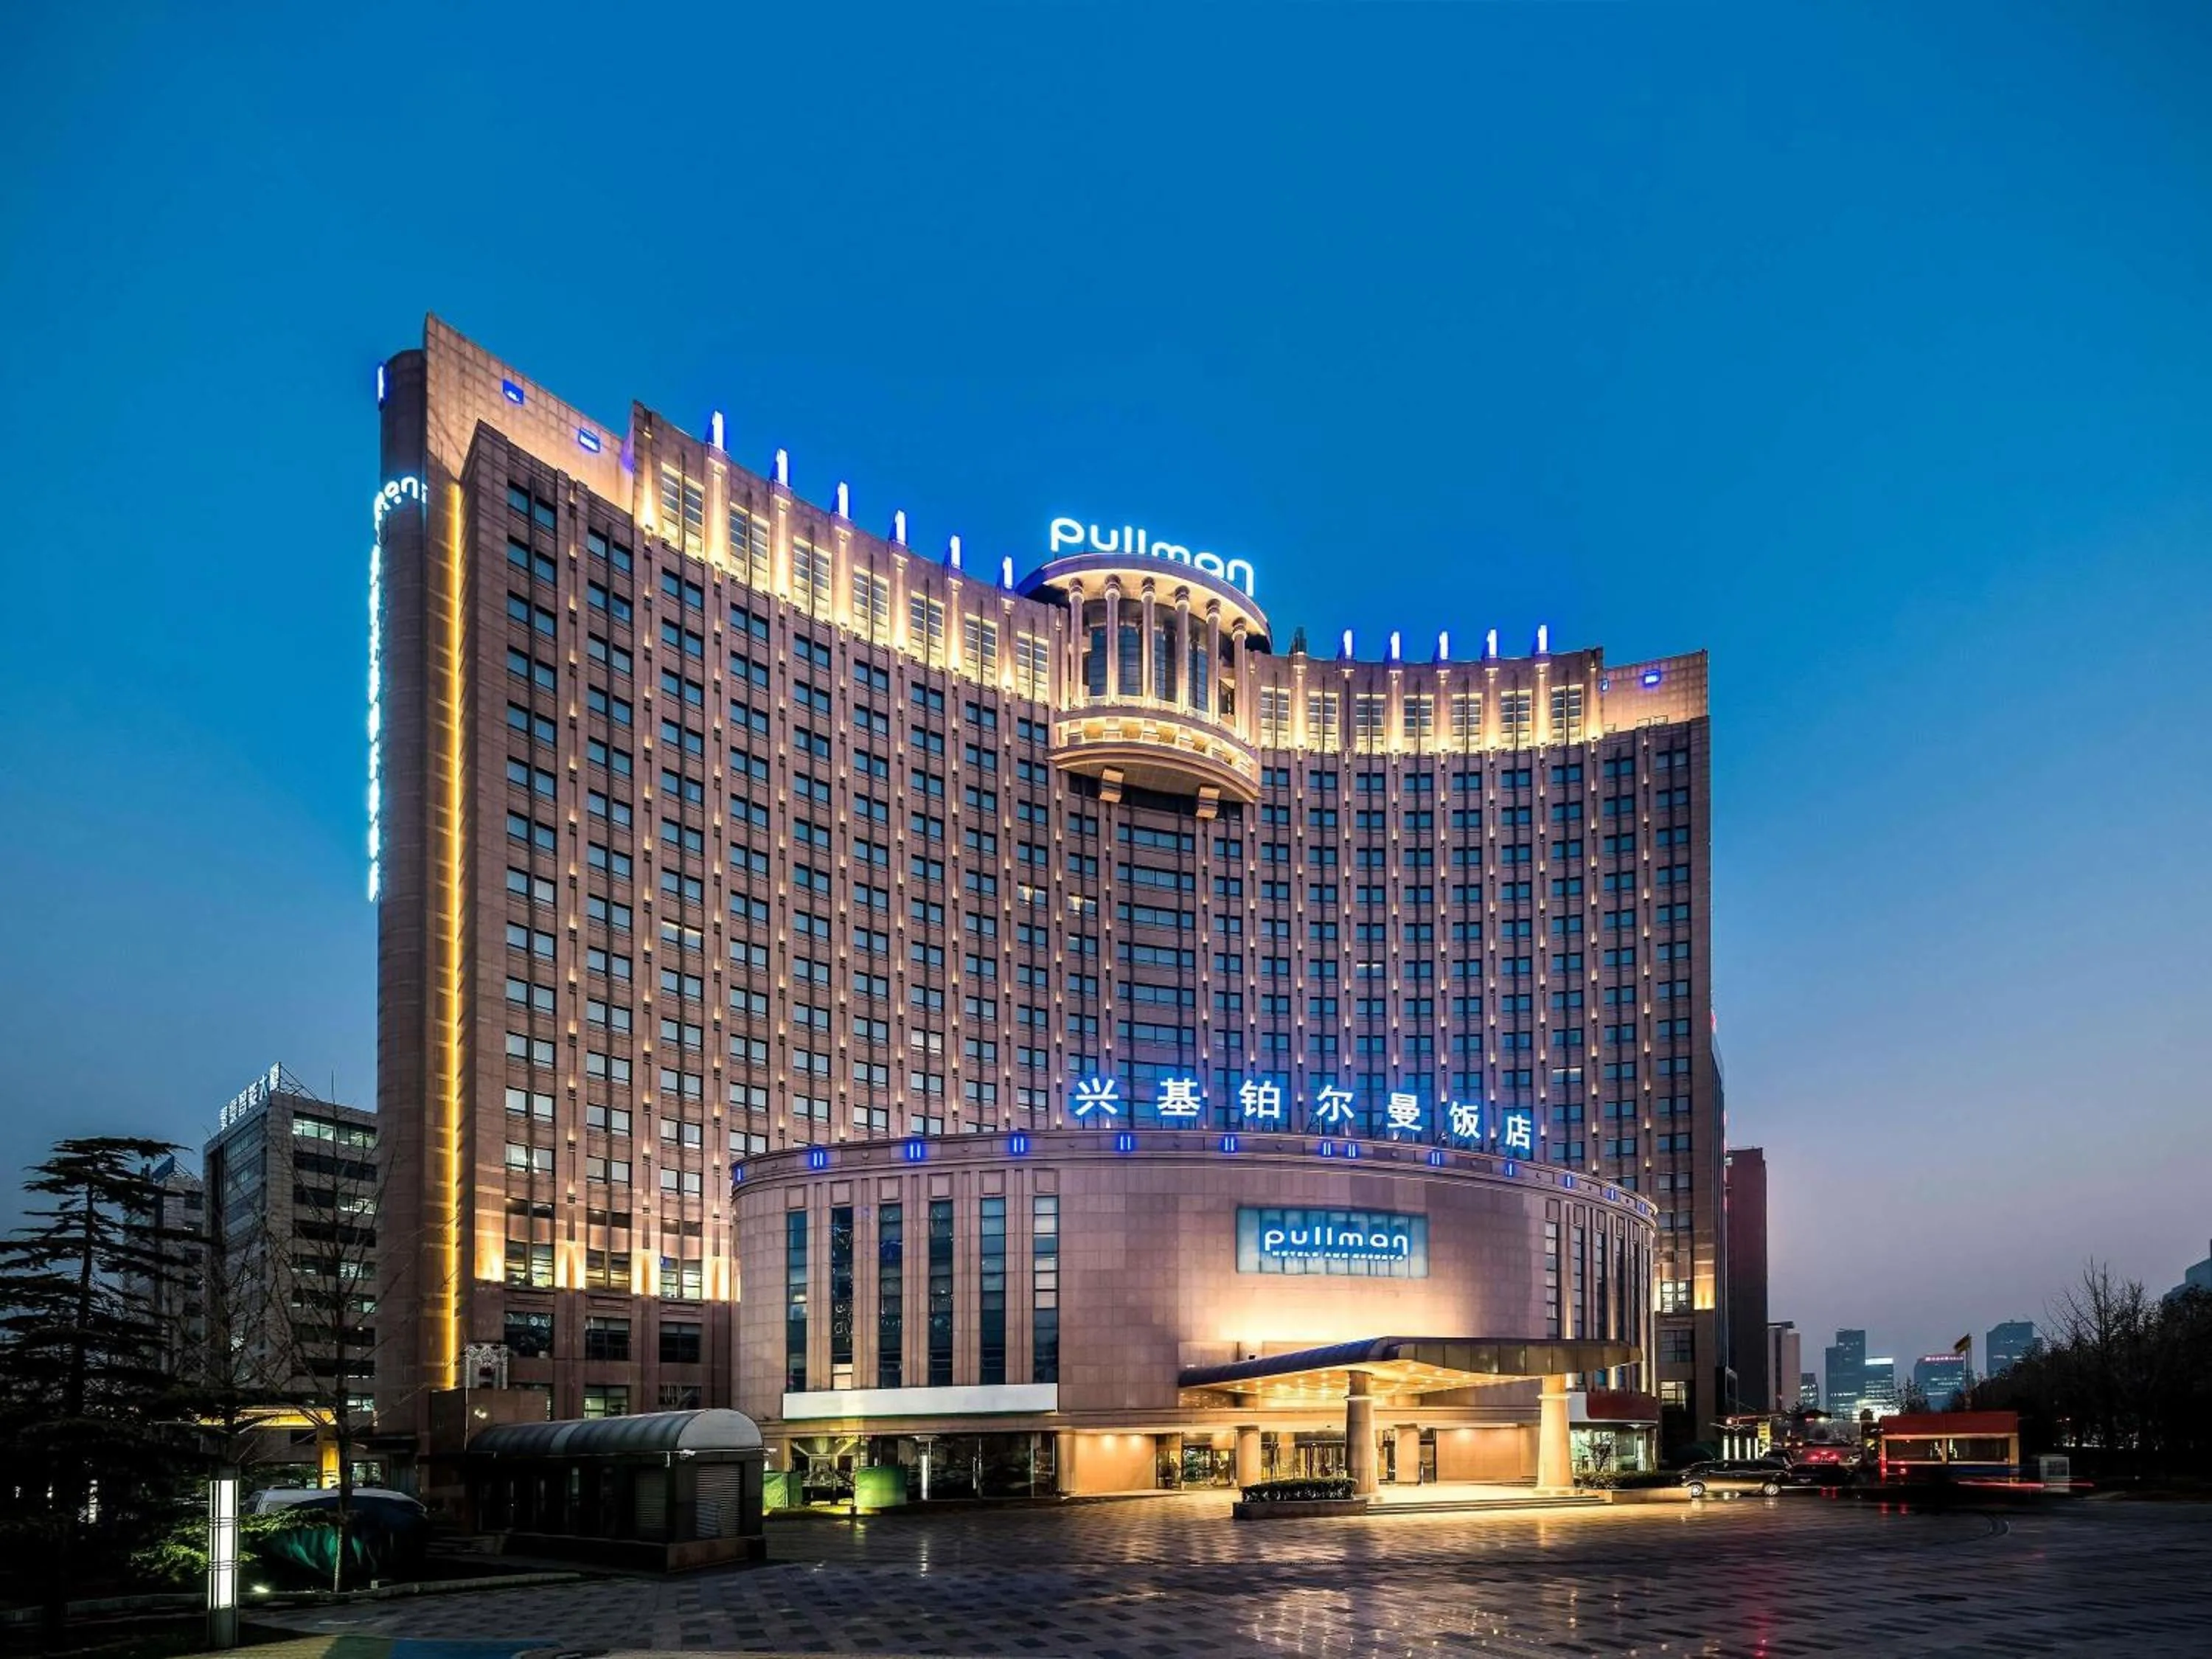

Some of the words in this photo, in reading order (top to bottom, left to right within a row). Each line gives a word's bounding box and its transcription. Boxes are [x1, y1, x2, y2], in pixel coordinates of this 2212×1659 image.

[1050, 517, 1255, 598] pullman
[1074, 1077, 1531, 1149] 兴基铂尔曼饭店
[1265, 1226, 1408, 1256] pullman
